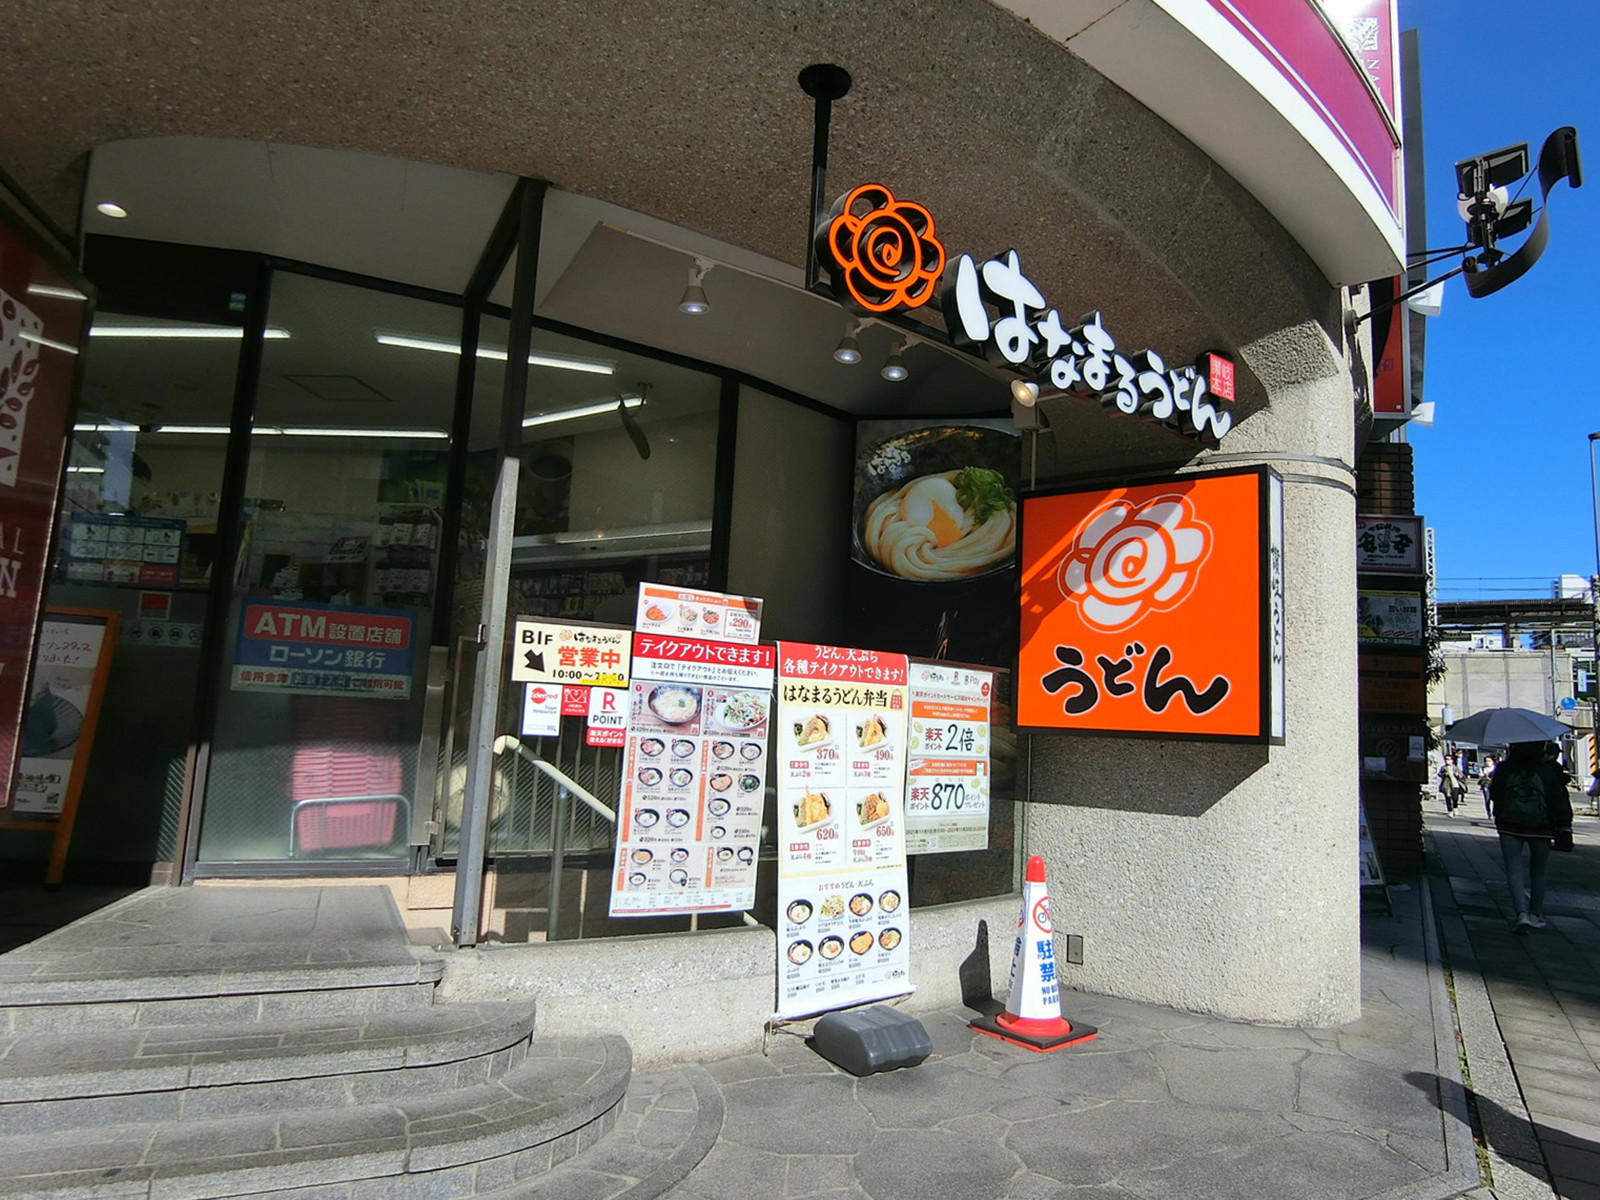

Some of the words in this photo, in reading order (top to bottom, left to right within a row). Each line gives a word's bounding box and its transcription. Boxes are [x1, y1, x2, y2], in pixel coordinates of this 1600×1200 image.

[956, 248, 1232, 440] はなまるうどん
[522, 629, 553, 646] BIF
[271, 645, 387, 669] ローソン銀行
[558, 646, 621, 669] 営業中
[640, 638, 770, 666] テイクアウトできます!
[815, 645, 879, 664] うどん、天ぷら
[784, 658, 904, 682] 各種テイクアウトできます!
[1042, 641, 1230, 716] うどん
[602, 692, 616, 711] R
[784, 685, 888, 707] はなまるうどん弁当
[593, 714, 624, 725] POINT
[925, 728, 943, 742] 楽天
[946, 723, 975, 752] 2倍
[925, 743, 943, 751] ポイント
[910, 803, 930, 811] ポイント
[911, 787, 930, 801] 楽天
[931, 783, 965, 810] 870
[1037, 940, 1057, 982] 駐禁
